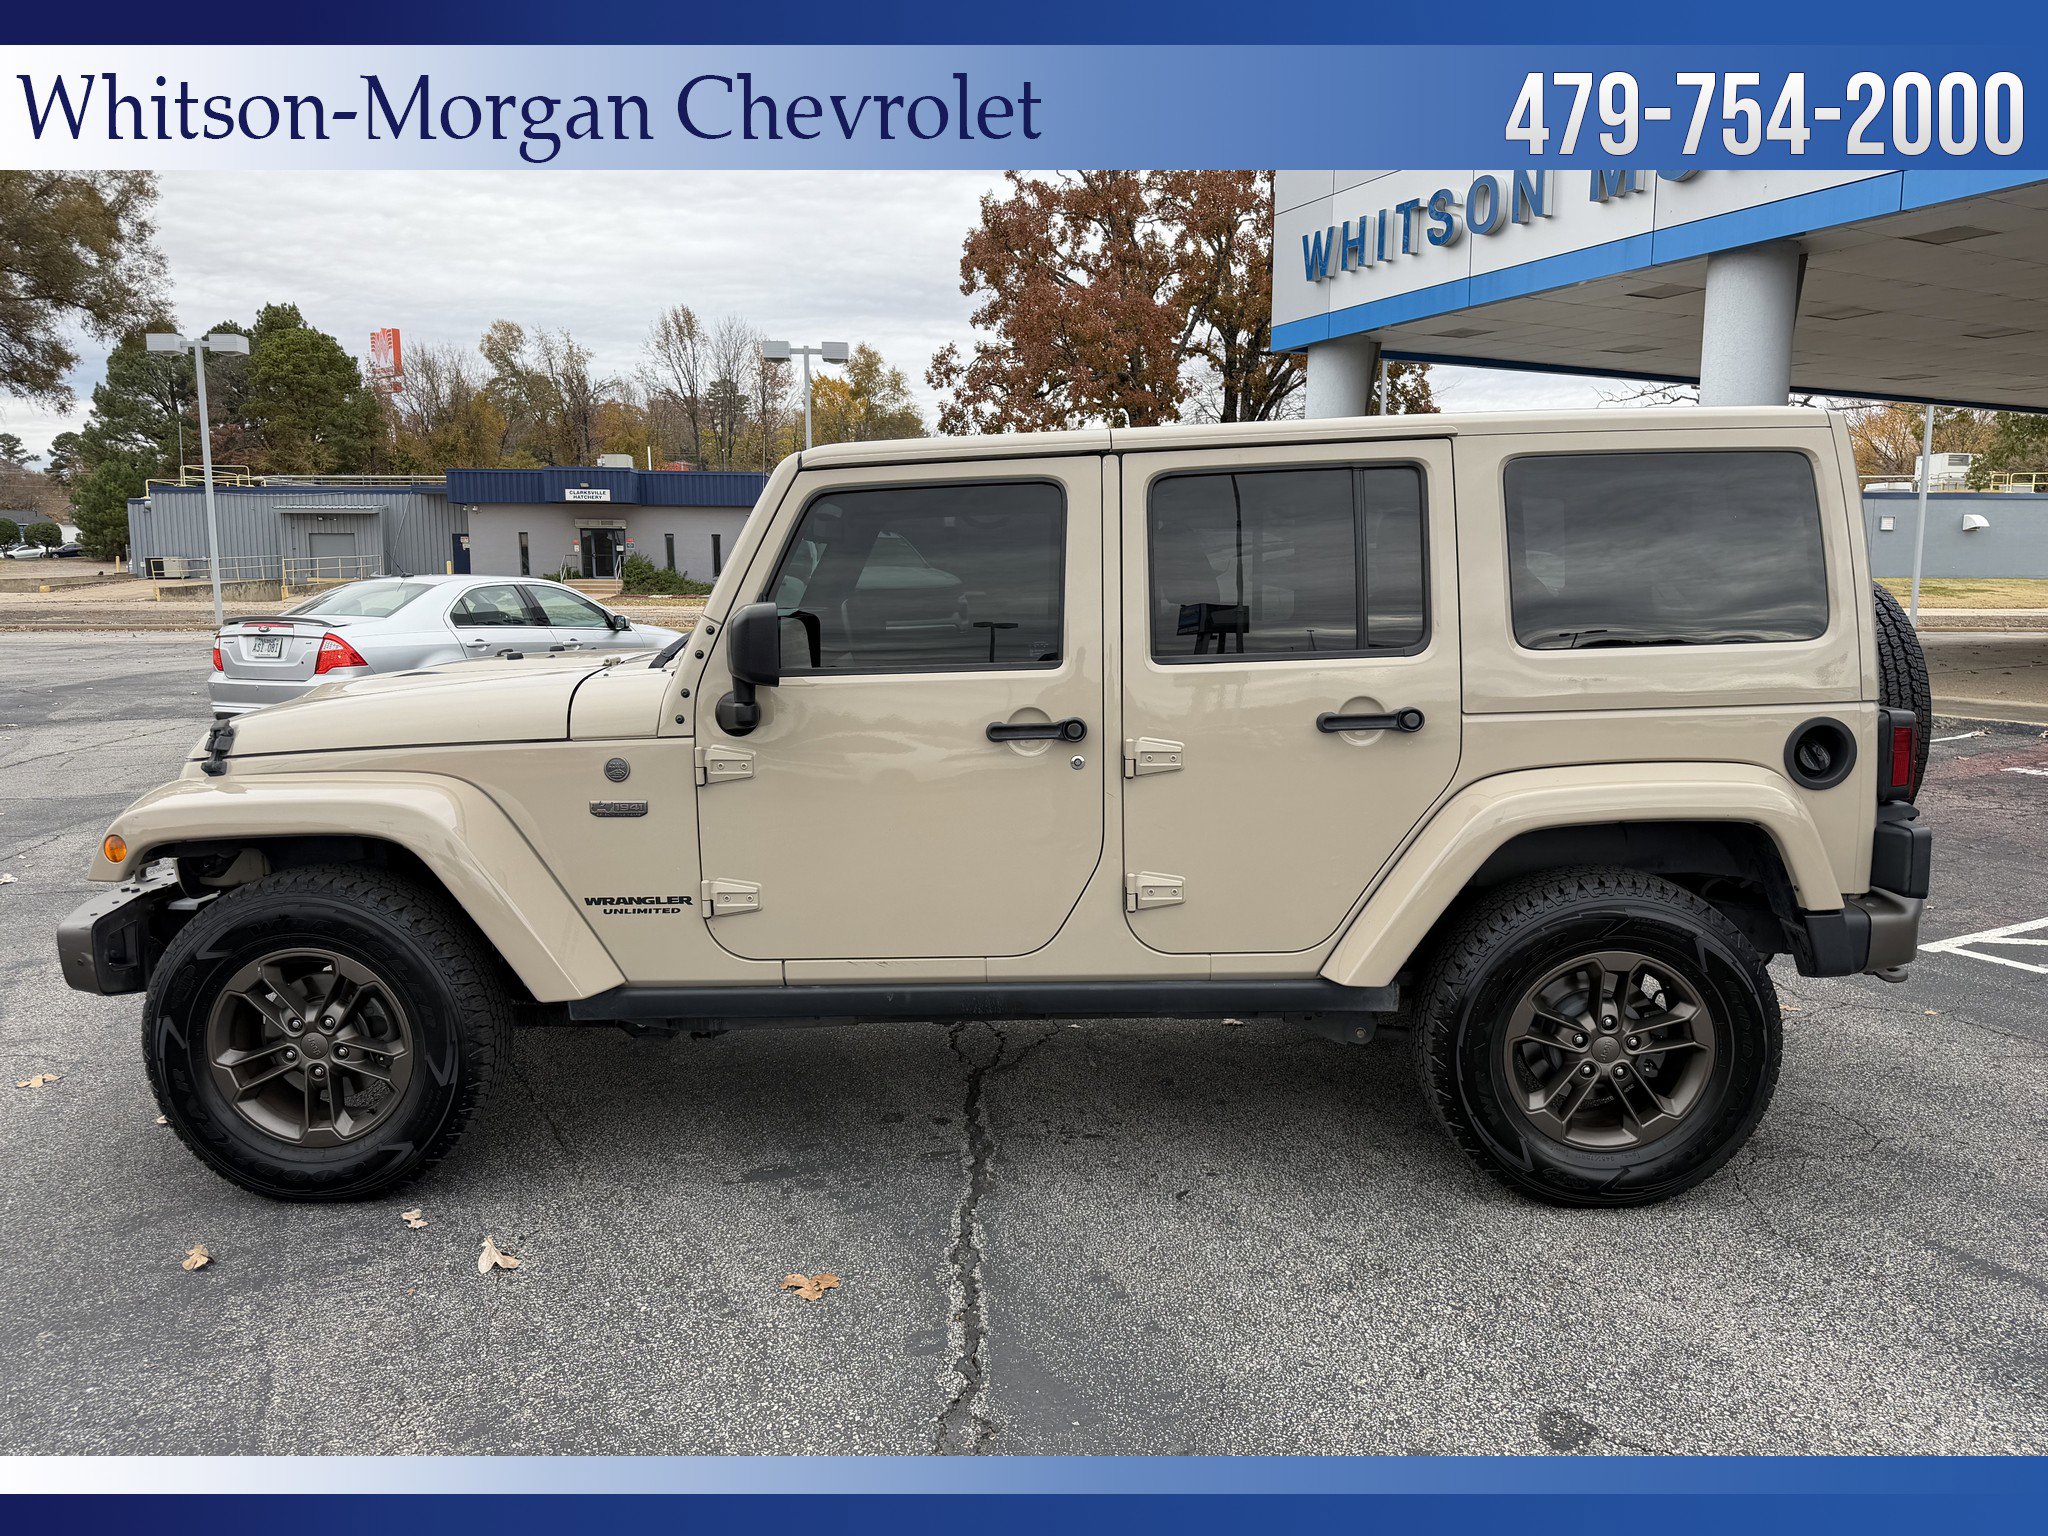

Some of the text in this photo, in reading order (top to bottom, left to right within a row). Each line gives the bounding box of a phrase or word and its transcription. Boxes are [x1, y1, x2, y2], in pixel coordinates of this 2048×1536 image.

[1302, 170, 1553, 283] WHITSON
[614, 803, 644, 811] 1941
[584, 895, 693, 906] WRANGLER
[603, 907, 681, 915] UNLIMITED
